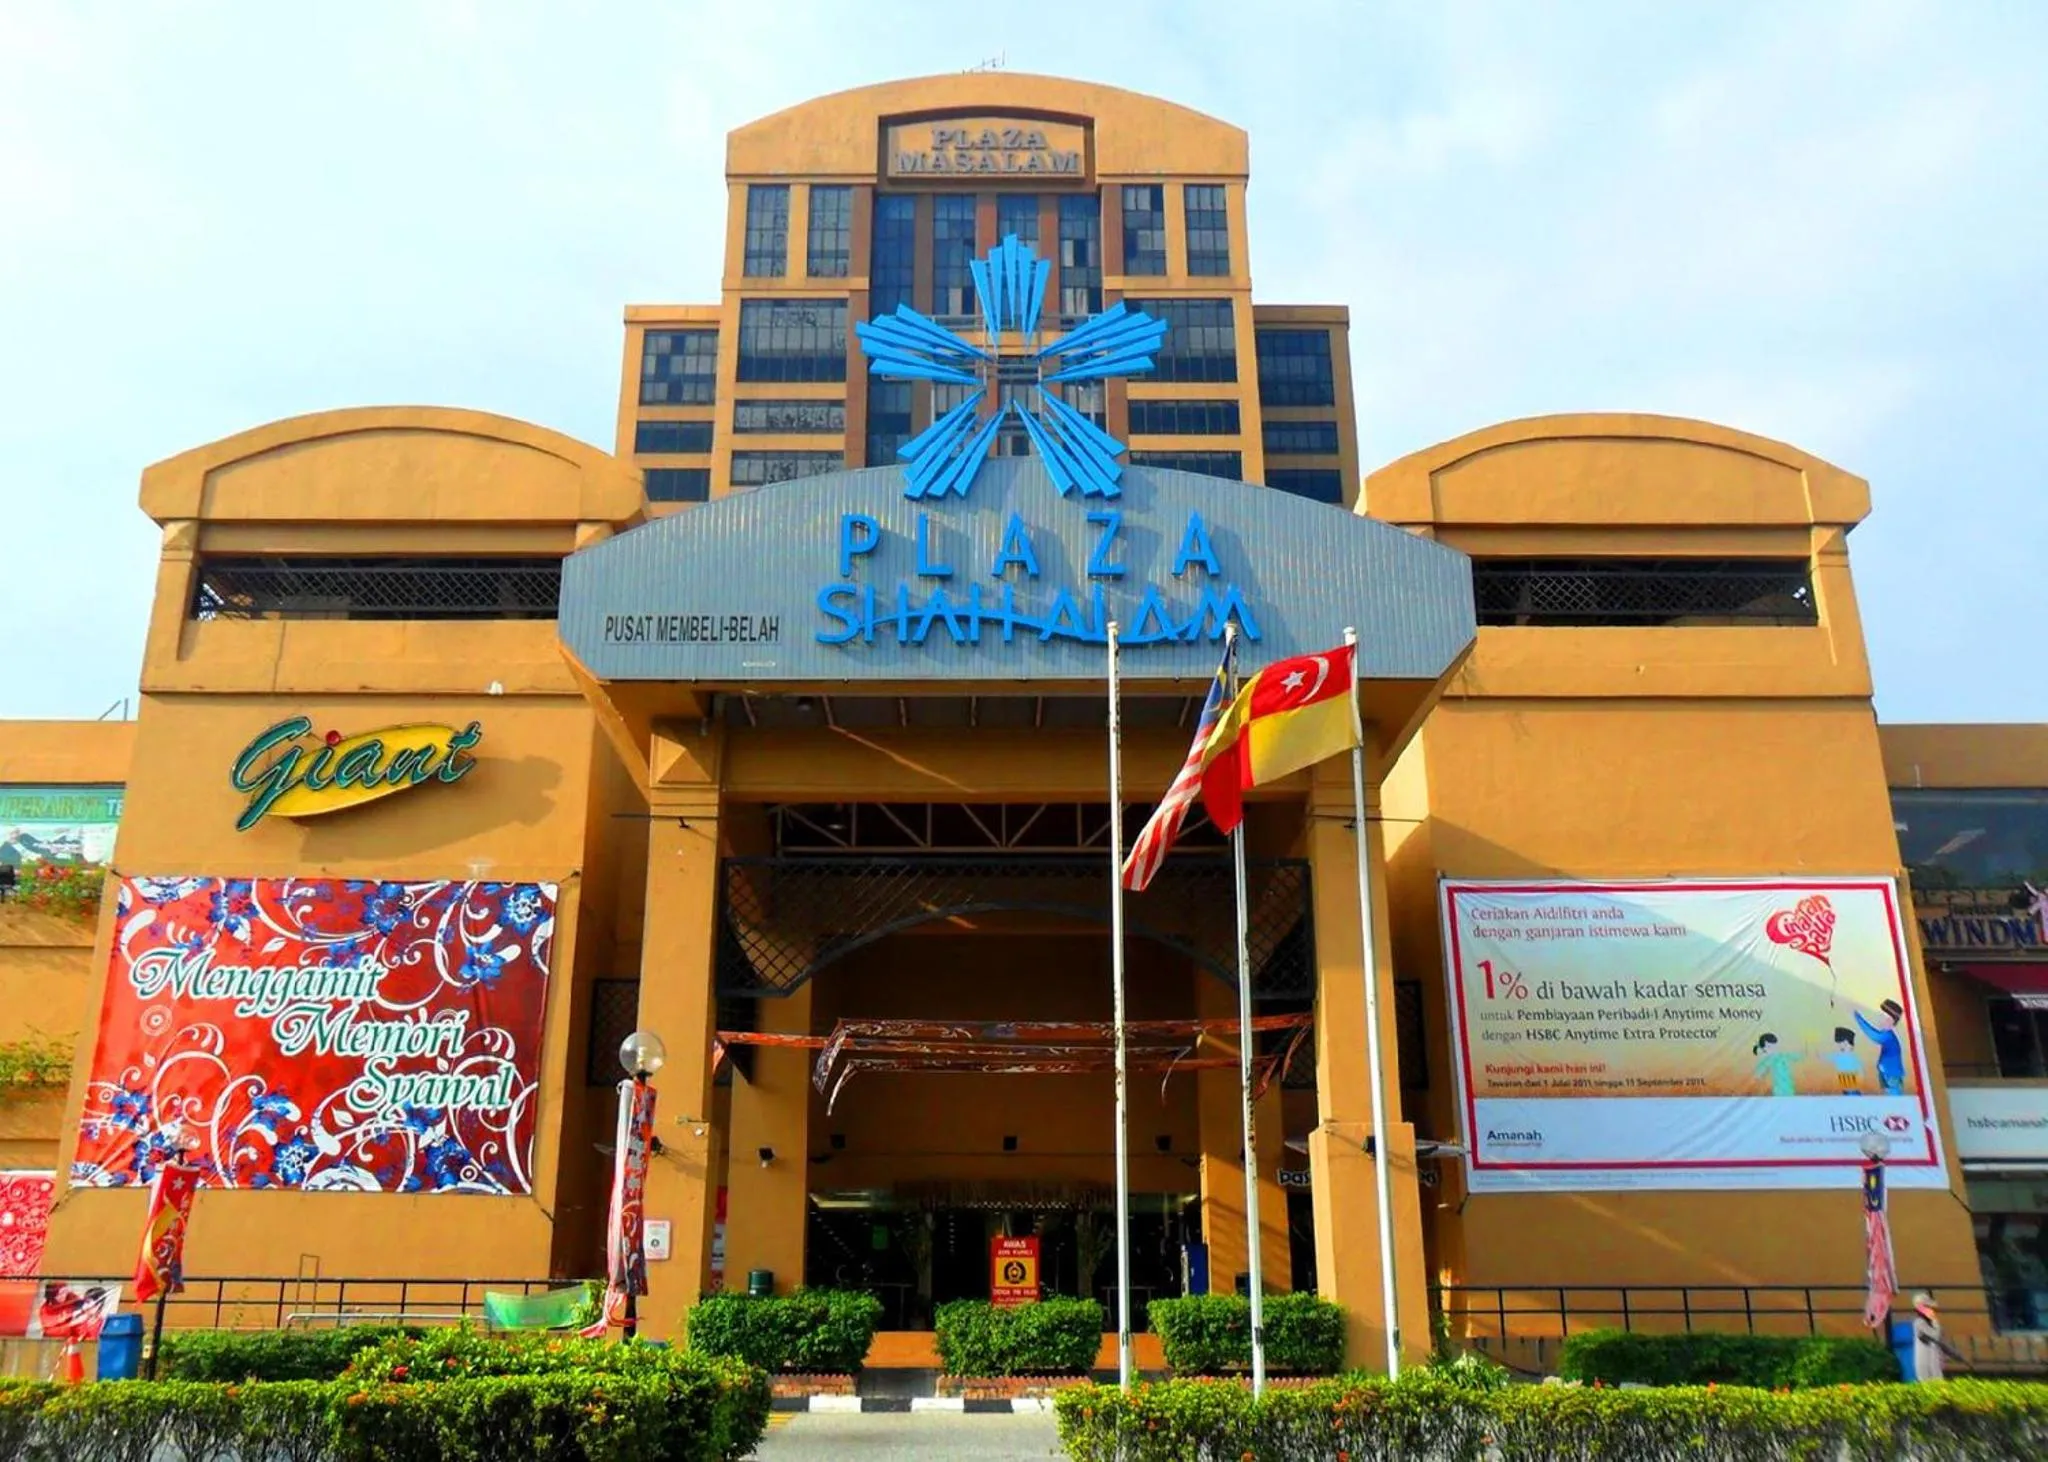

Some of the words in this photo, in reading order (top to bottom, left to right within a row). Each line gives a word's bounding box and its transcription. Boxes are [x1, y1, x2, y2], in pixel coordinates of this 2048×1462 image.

[931, 128, 1047, 150] PLAZA
[895, 151, 1080, 174] MASALAM
[841, 510, 1221, 577] PLAZA
[605, 615, 653, 642] PUSAT
[656, 615, 780, 642] MEMBELI-BELAH
[230, 716, 483, 832] Giant
[1471, 907, 1529, 920] Ceriakan
[1534, 906, 1588, 920] Aidilfitri
[1592, 906, 1625, 920] anda
[1473, 925, 1520, 940] dengan
[1525, 926, 1585, 941] ganjaran
[1588, 923, 1649, 937] istimewa
[1653, 922, 1687, 937] kami
[130, 947, 384, 1016] Menggamit
[1536, 980, 1554, 1000] di
[1560, 979, 1627, 1000] bawah
[1633, 979, 1688, 999] kadar
[1694, 982, 1767, 998] semasa
[1480, 1009, 1514, 1021] untuk
[1517, 1007, 1595, 1024] Pembiayaan
[1662, 1006, 1715, 1023] Anytime
[1719, 1006, 1762, 1022] Money
[273, 1005, 470, 1056] Memori
[1482, 1029, 1521, 1043] dengan
[1526, 1028, 1561, 1041] HSBC
[1564, 1028, 1620, 1044] Anytime
[1623, 1027, 1655, 1040] Extra
[1485, 1063, 1535, 1076] Kunjungi
[1537, 1063, 1563, 1074] kami
[347, 1056, 514, 1121] Syawal
[1487, 1129, 1543, 1141] Amanah
[1829, 1116, 1879, 1133] HSBC
